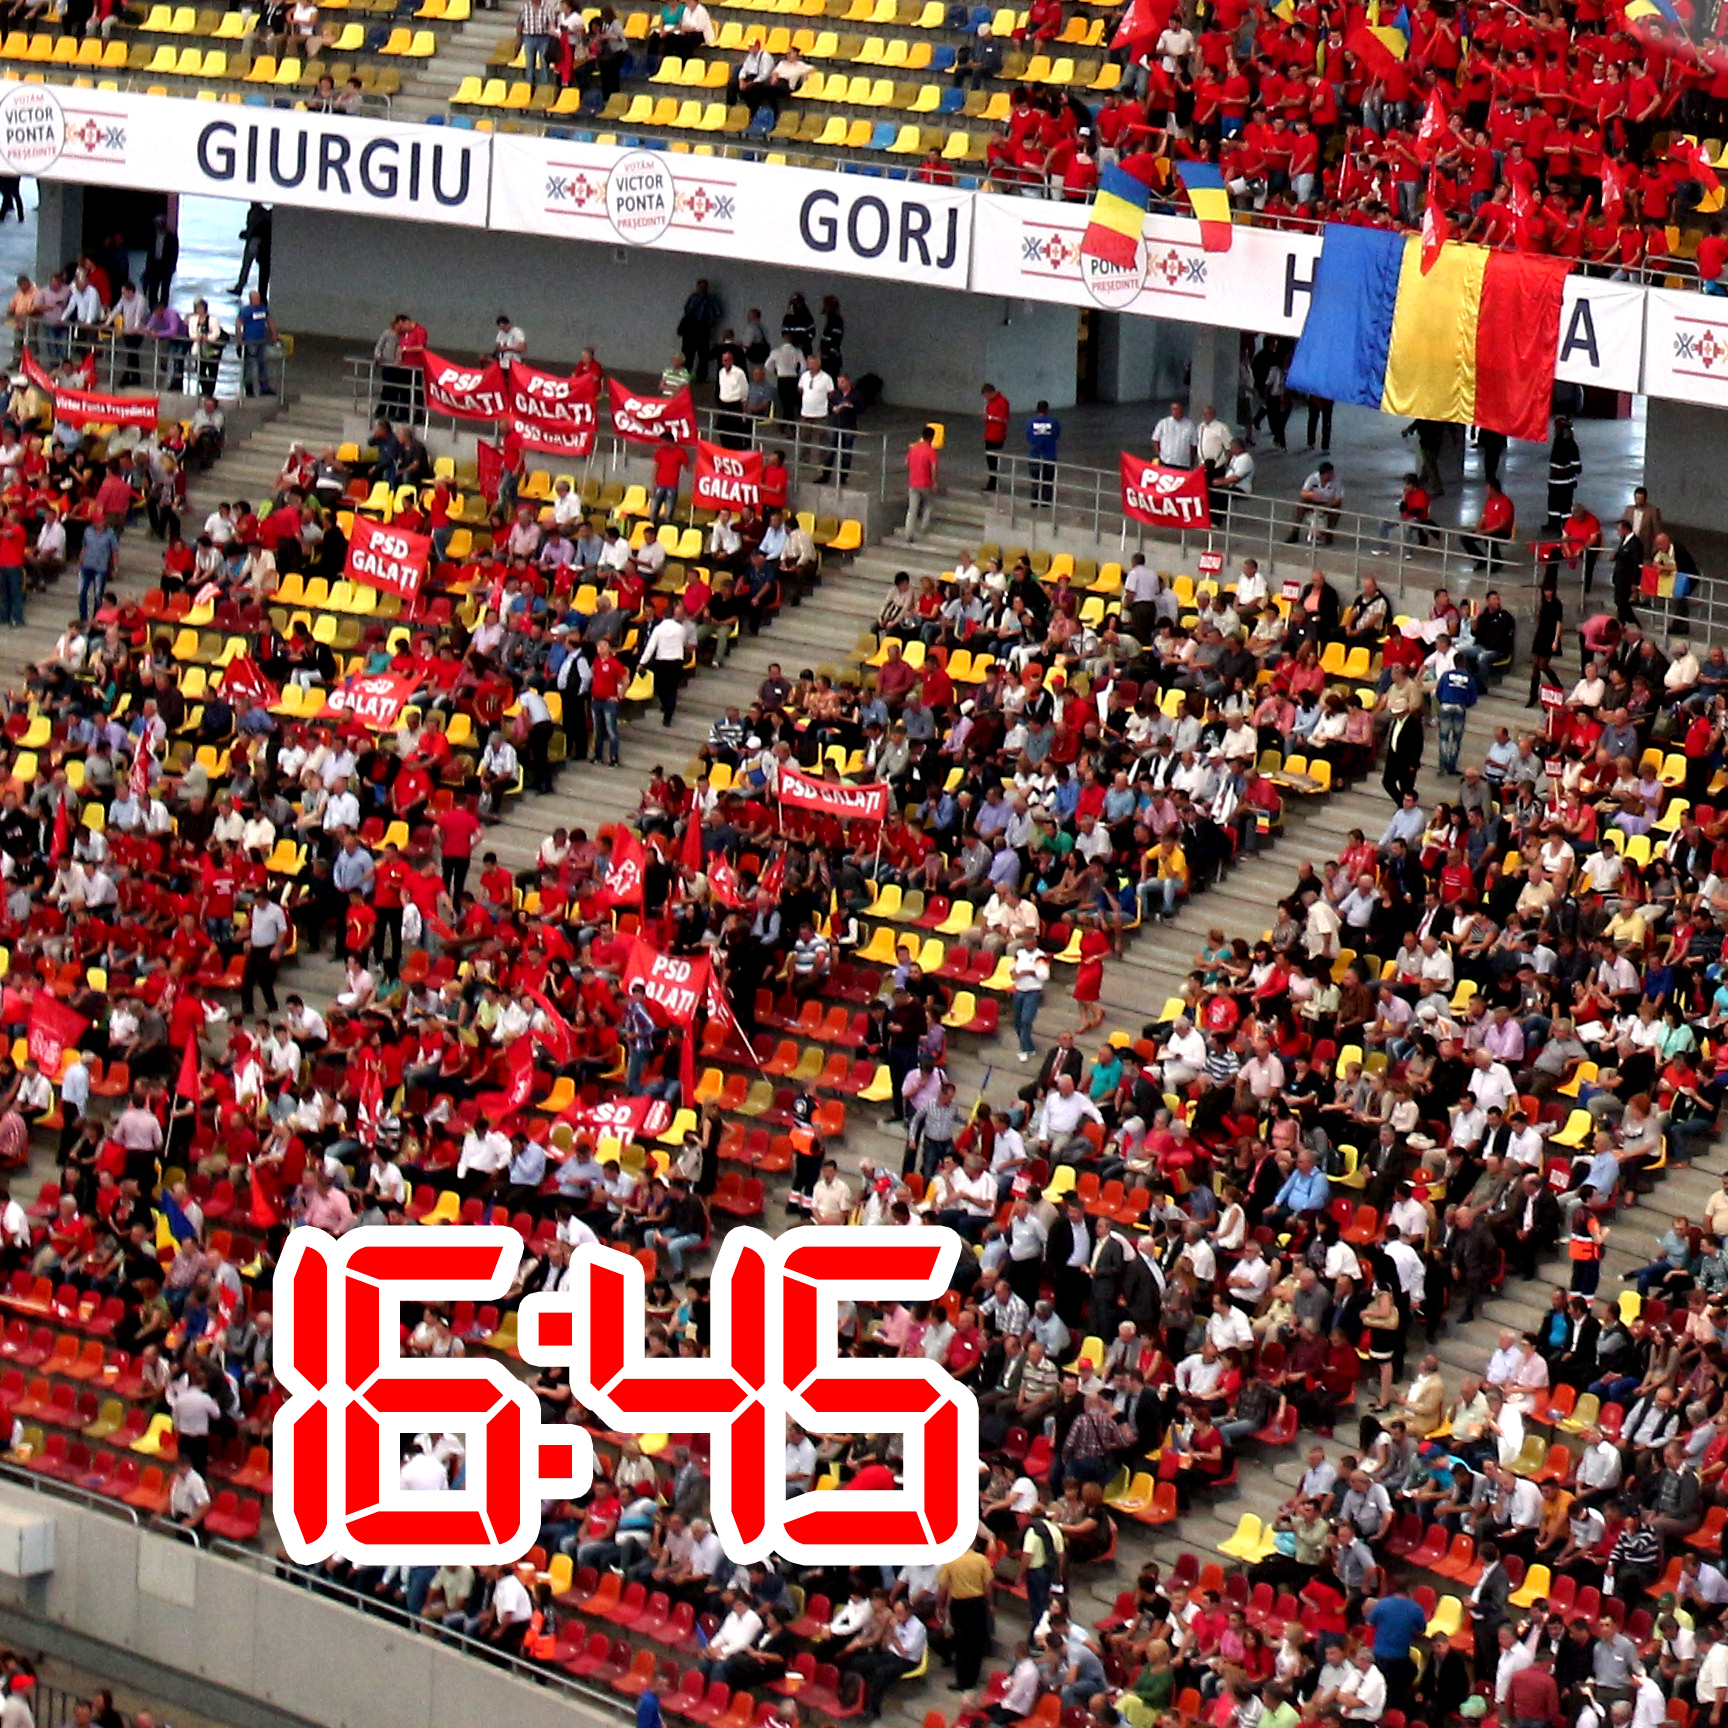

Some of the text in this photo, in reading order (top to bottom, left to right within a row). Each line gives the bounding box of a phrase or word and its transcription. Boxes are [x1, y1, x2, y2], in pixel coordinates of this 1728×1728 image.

[5, 107, 54, 124] VICTOR
[5, 127, 55, 145] PONTA
[197, 120, 471, 206] GIURGIU
[615, 174, 664, 192] VICTOR
[616, 194, 665, 214] PONTA
[800, 189, 958, 269] GORJ
[526, 375, 570, 399] PSD
[712, 455, 744, 477] PSD
[1126, 487, 1203, 523] GALAȚI
[368, 532, 408, 557] PSD
[351, 551, 419, 591] GALAȚI
[781, 776, 818, 799] PSD
[651, 954, 691, 982] PSD
